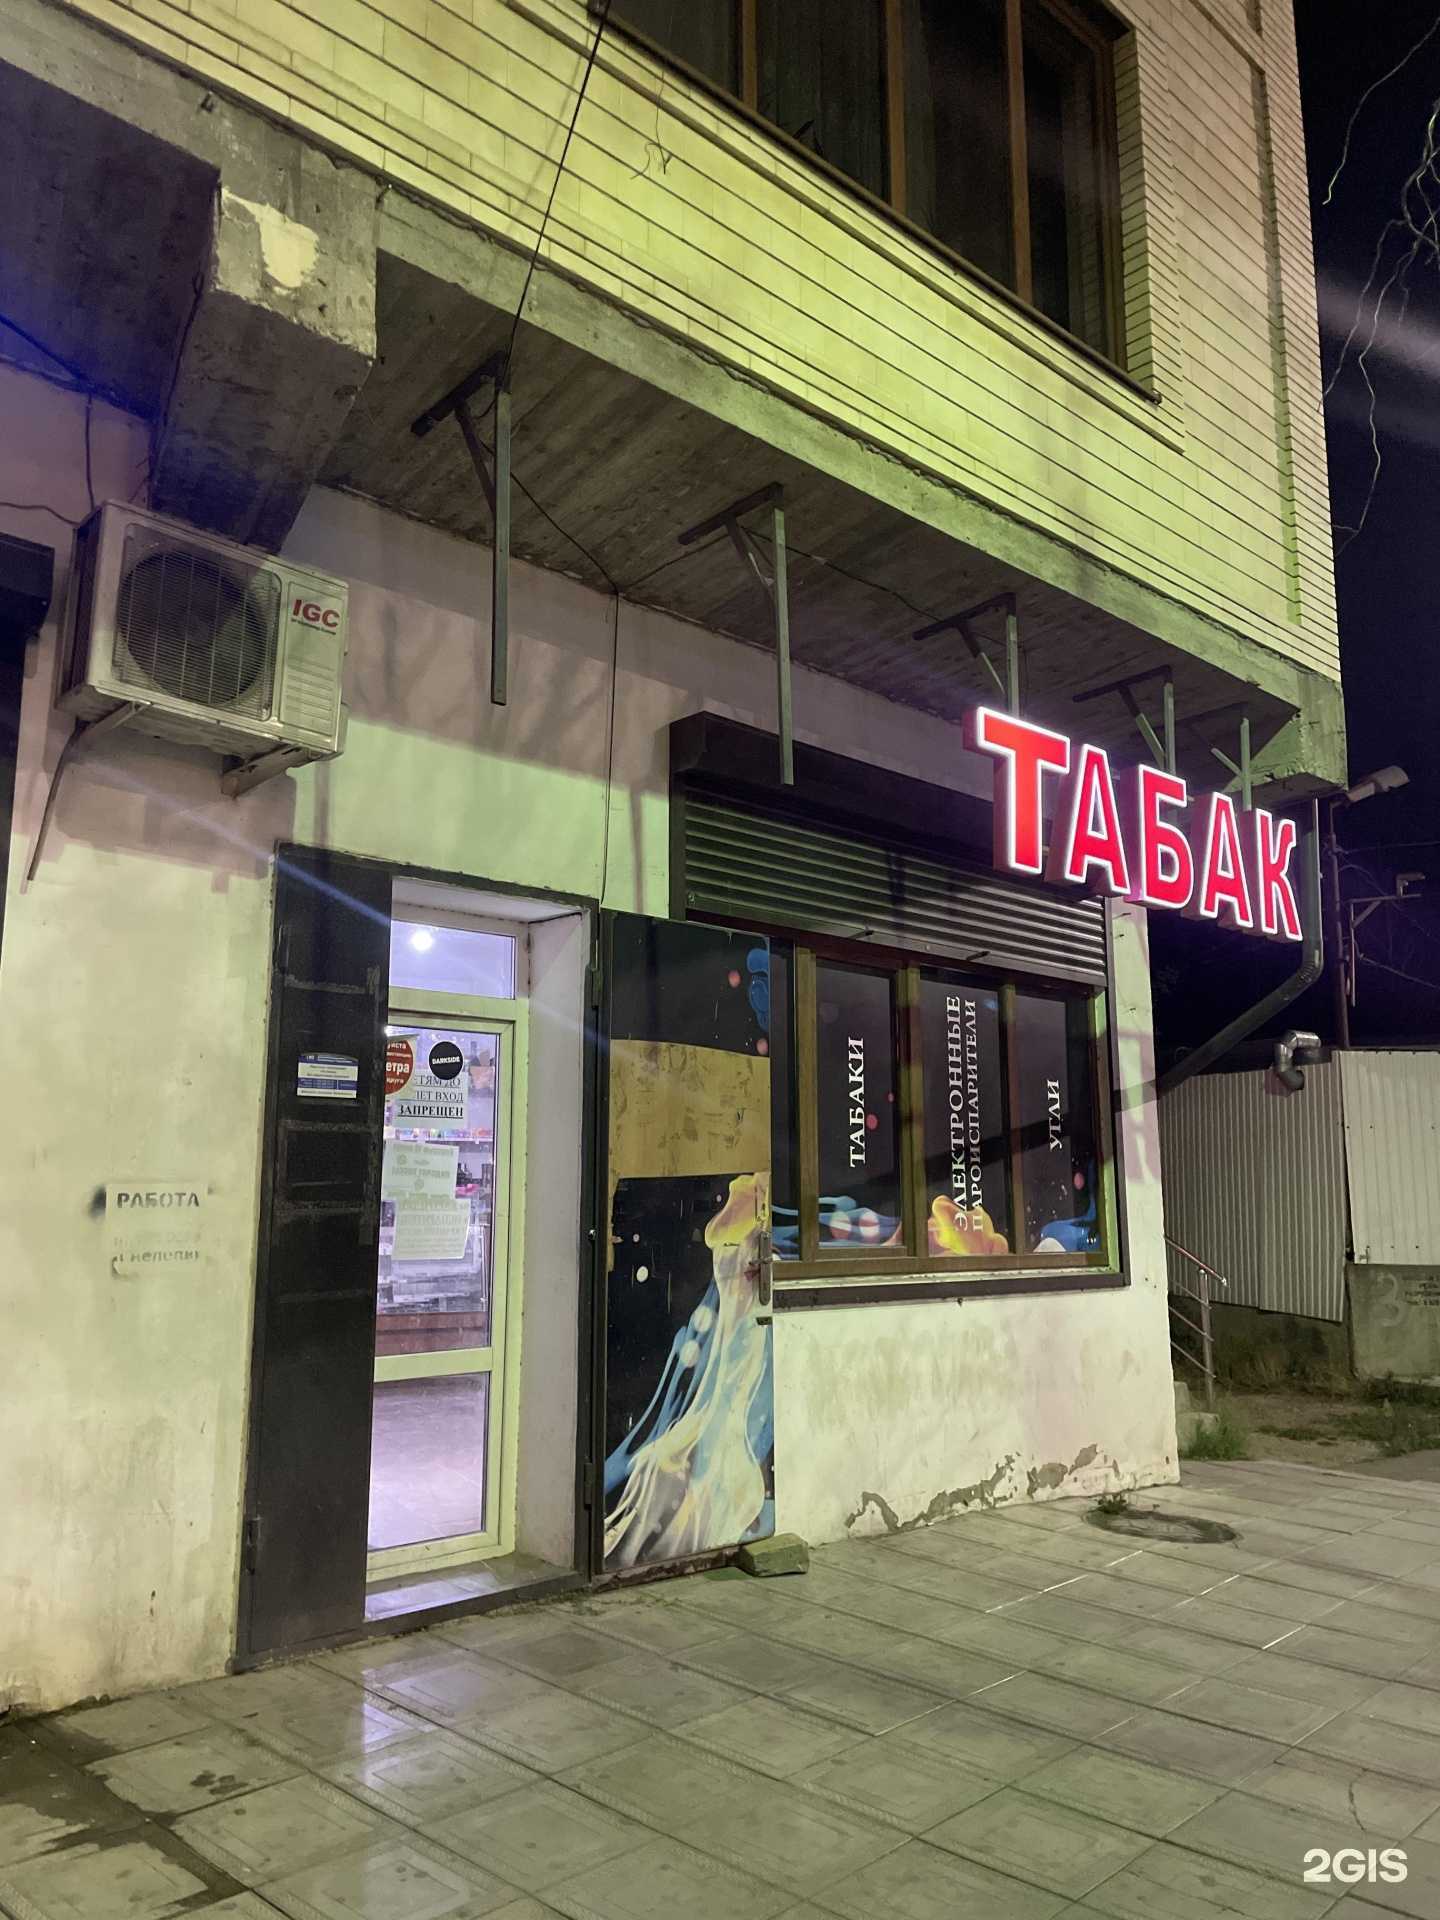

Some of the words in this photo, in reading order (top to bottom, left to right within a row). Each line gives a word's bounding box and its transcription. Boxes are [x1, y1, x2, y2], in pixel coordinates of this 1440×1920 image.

[293, 599, 340, 628] IGC
[976, 706, 1304, 941] ТАБАК
[385, 1061, 410, 1076] етра
[432, 1056, 461, 1065] DARKSIDE
[435, 1092, 463, 1104] ВХОД
[848, 1036, 866, 1168] ТАБАКИ
[946, 995, 968, 1232] ЭЛЕКТРОННЫЕ
[1047, 1079, 1063, 1152] УГЛИ
[117, 1192, 200, 1208] РАБОТА
